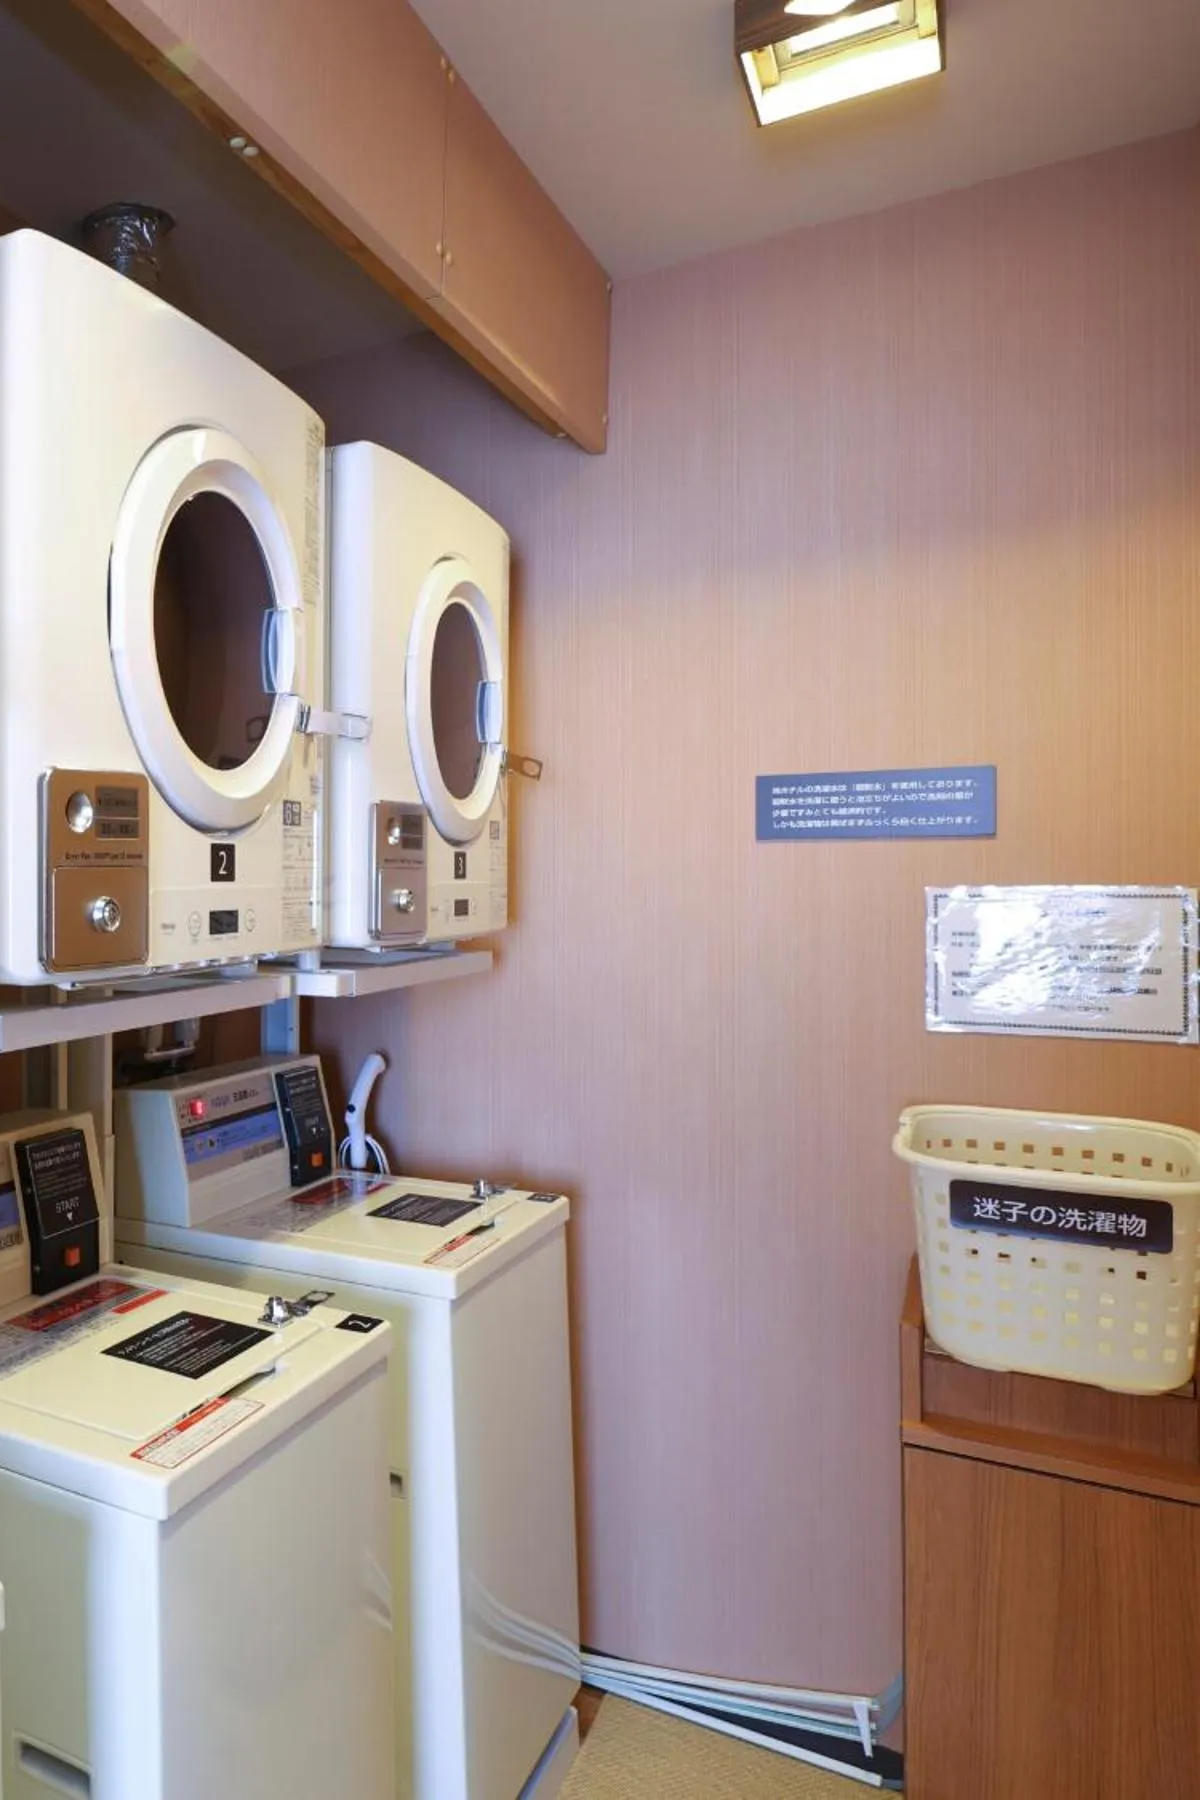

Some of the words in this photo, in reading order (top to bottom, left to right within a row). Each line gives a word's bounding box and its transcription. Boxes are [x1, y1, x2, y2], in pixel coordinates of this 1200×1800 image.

[218, 851, 228, 875] 2
[972, 1196, 1149, 1238] 迷子の洗濯物
